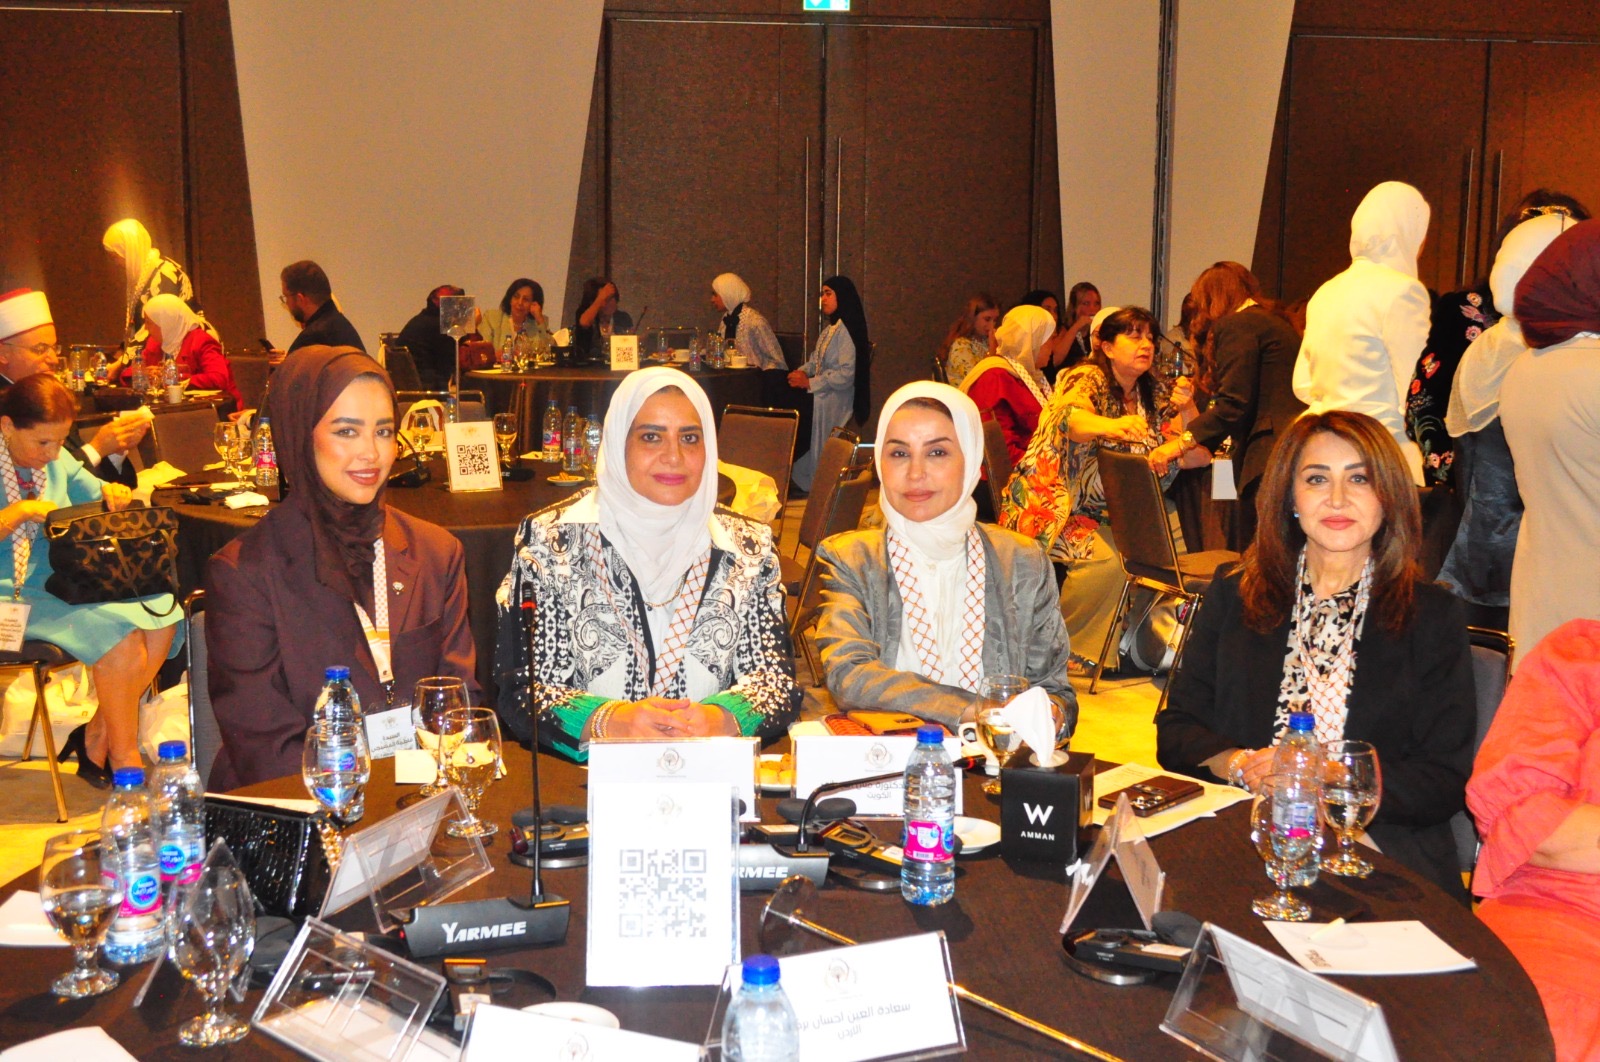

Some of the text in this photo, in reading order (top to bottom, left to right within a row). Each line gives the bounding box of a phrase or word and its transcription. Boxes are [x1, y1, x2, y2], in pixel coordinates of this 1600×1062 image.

[866, 791, 891, 801] الكويت
[1023, 803, 1054, 826] W
[1021, 831, 1055, 841] AMMAN
[441, 921, 527, 944] YARMEE
[847, 1006, 874, 1023] العين
[877, 1002, 911, 1016] سعادة
